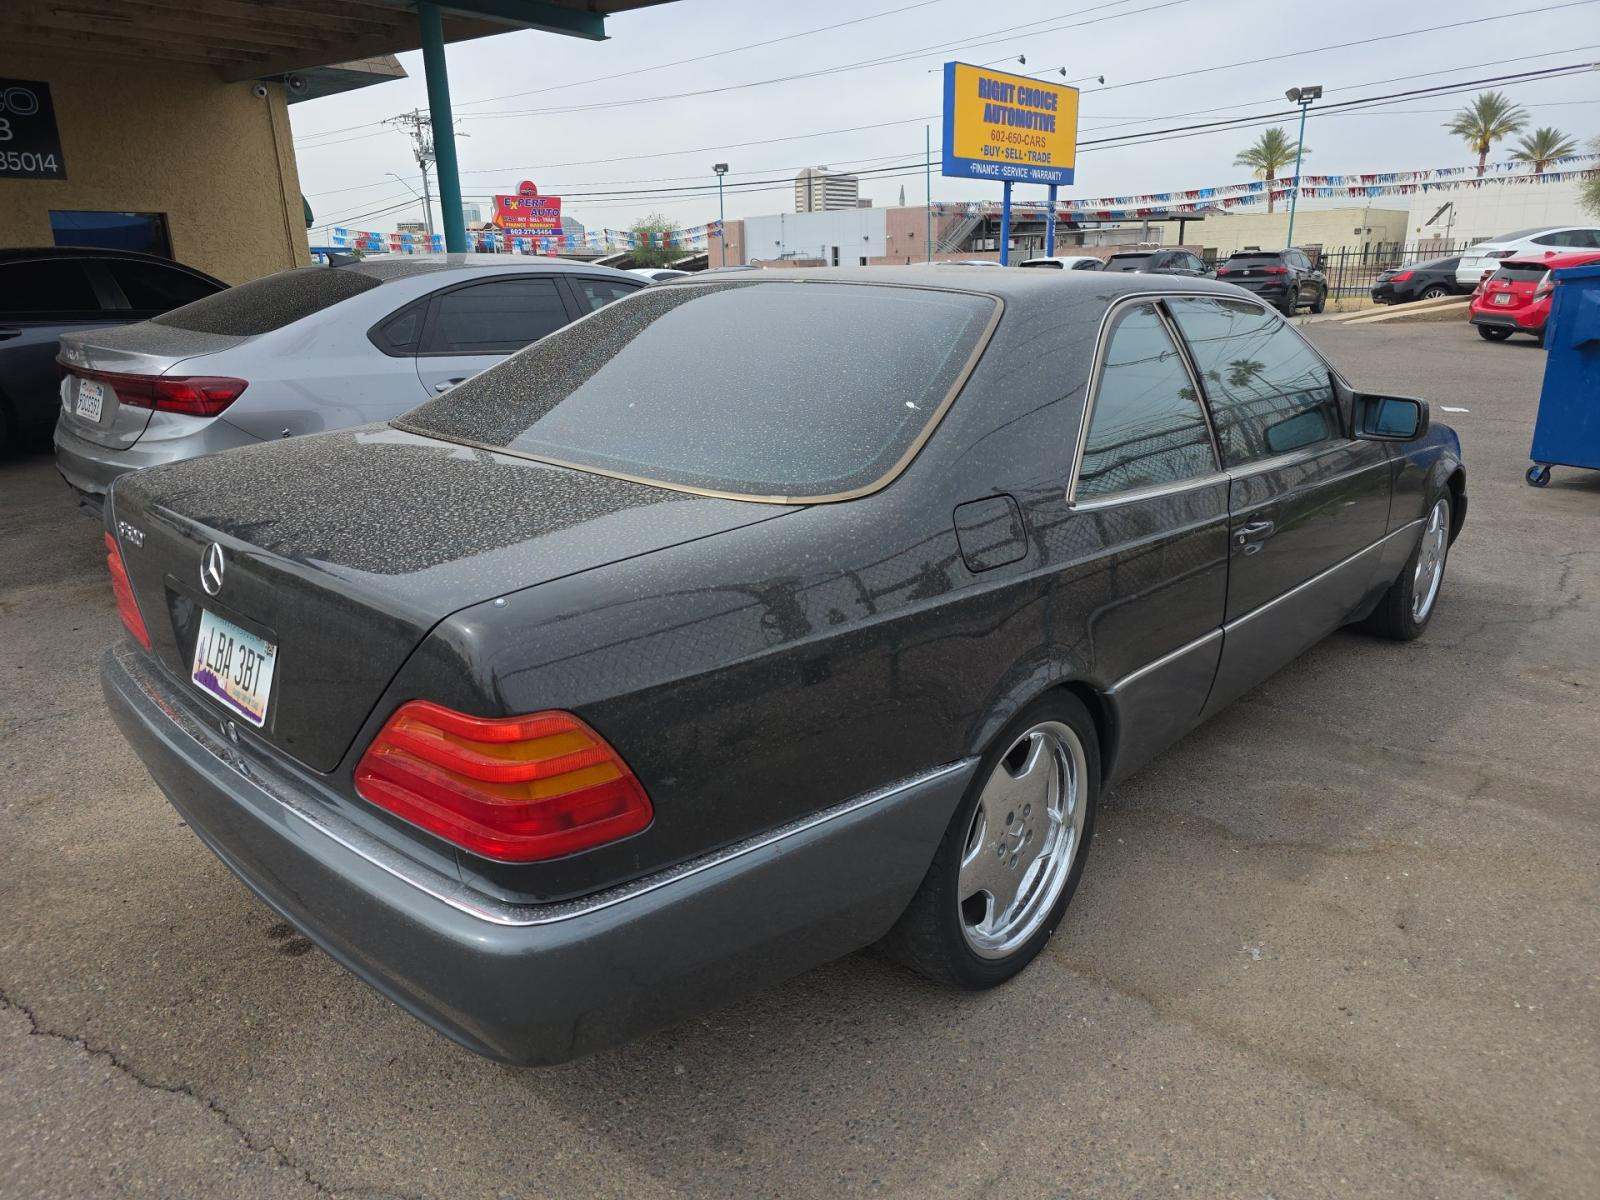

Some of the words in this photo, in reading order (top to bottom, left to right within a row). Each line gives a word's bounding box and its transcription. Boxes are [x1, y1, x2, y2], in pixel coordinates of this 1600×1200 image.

[978, 77, 1015, 104] RIGHT
[1017, 86, 1058, 111] CHOICE
[983, 103, 1056, 133] AUTOMOTIVE
[990, 129, 1046, 148] 602-650-CARS
[983, 144, 1000, 157] BUY
[1004, 147, 1023, 160] SELL
[1027, 150, 1051, 163] TRADE
[971, 162, 999, 176] FINANCE
[1002, 166, 1031, 178] SERVICE
[1032, 169, 1063, 181] WARRANTY
[530, 208, 560, 217] AUTO
[205, 627, 234, 679] LBA
[234, 644, 265, 697] 3BT
